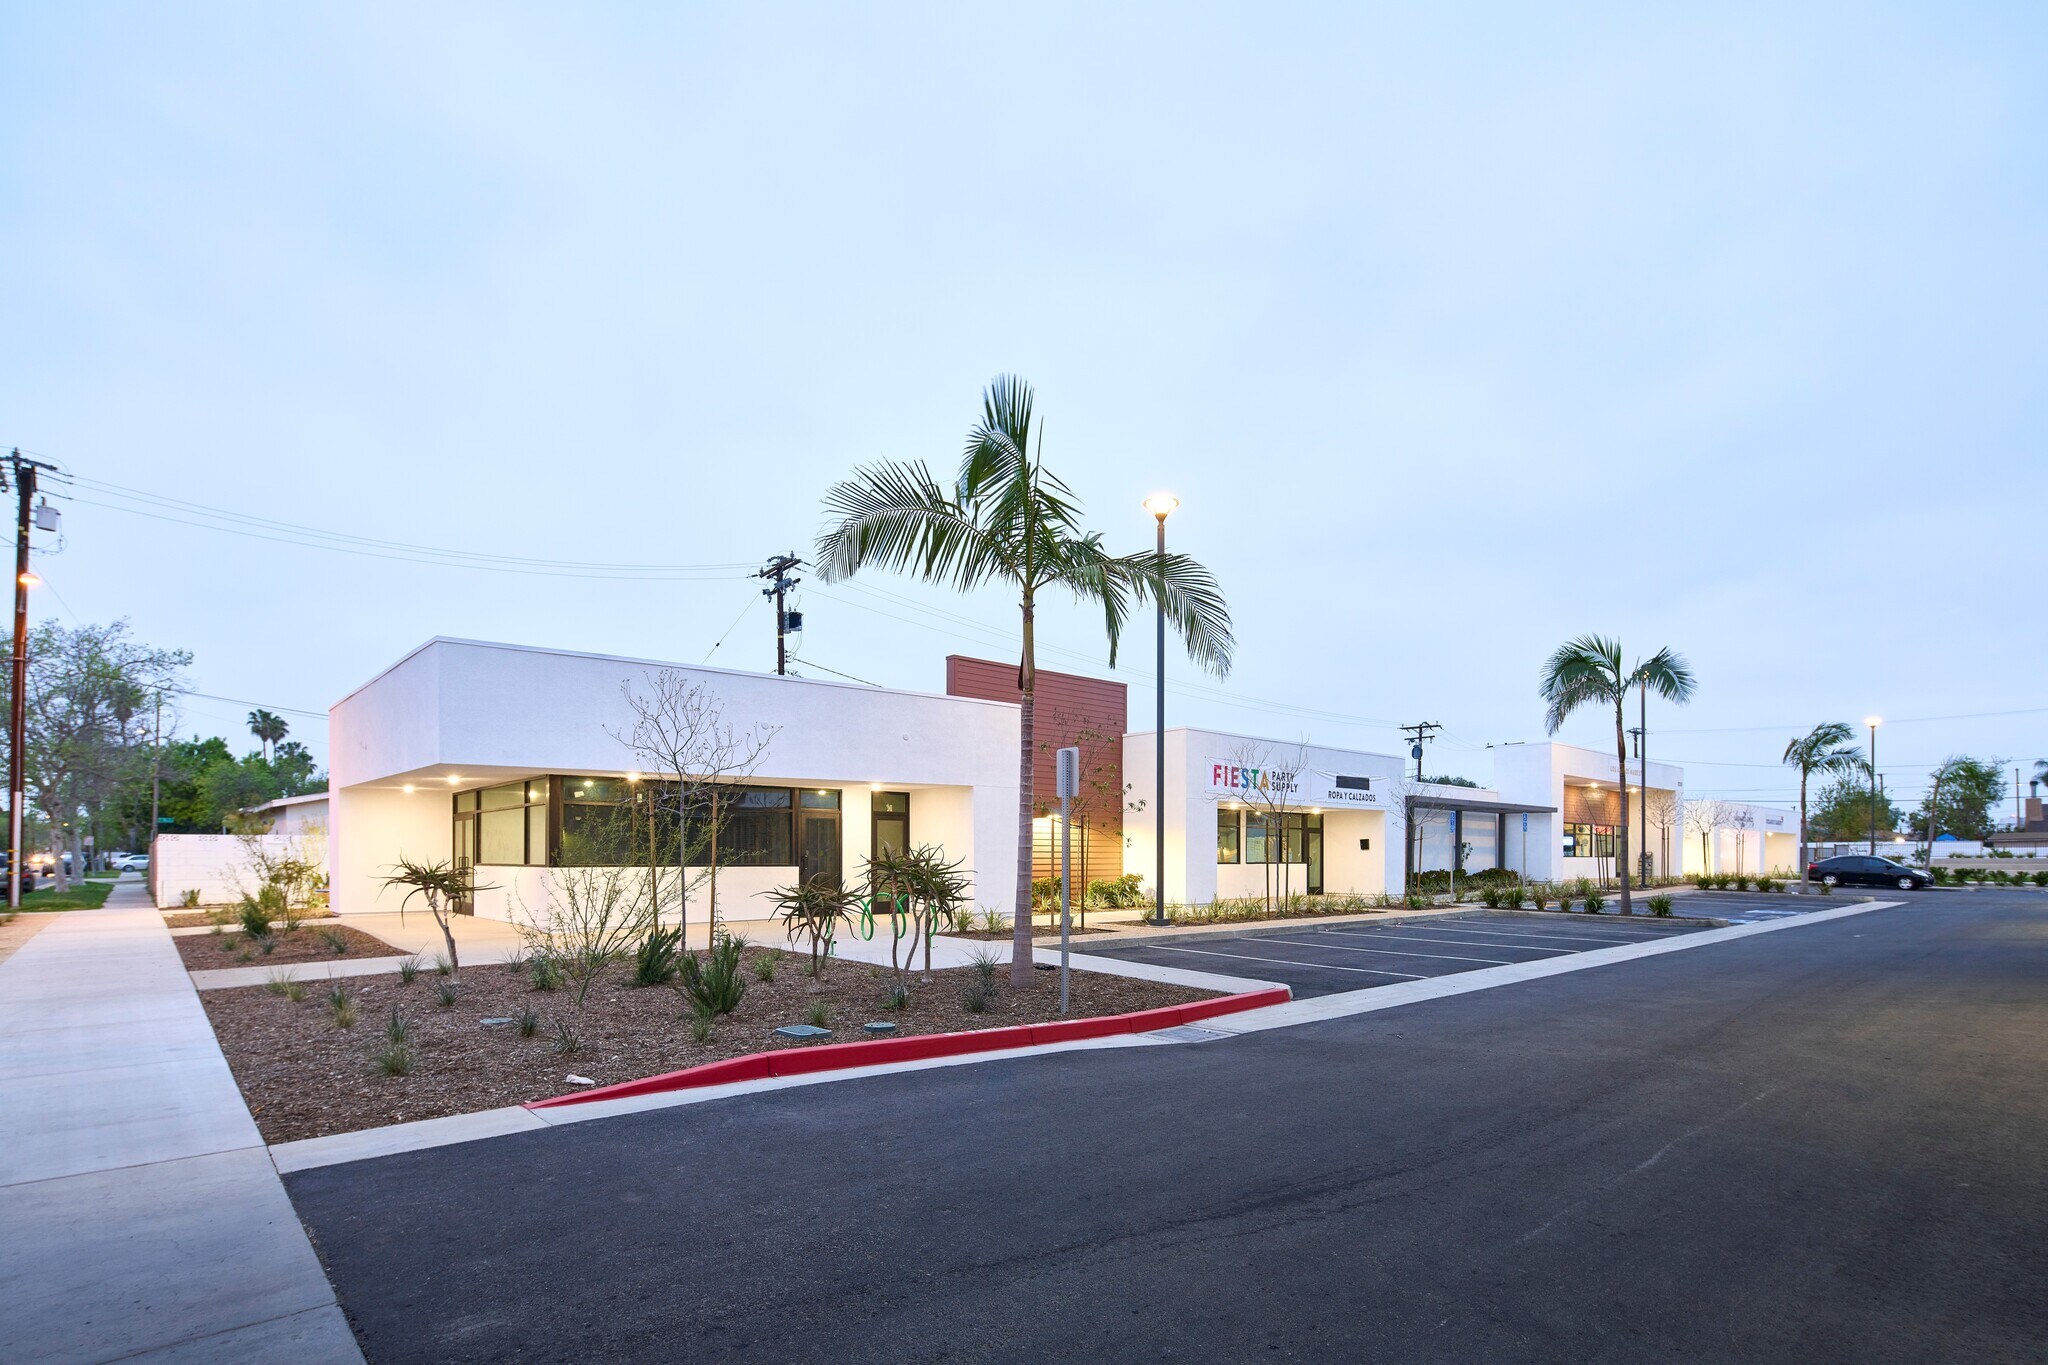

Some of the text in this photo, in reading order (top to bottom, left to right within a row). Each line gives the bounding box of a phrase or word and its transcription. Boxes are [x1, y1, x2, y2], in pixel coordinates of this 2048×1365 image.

[1213, 764, 1270, 791] FIESTA
[1271, 771, 1294, 782] PARTY
[1271, 781, 1299, 793] SUPPLY
[1328, 790, 1376, 802] ROPA Y CALZADOS
